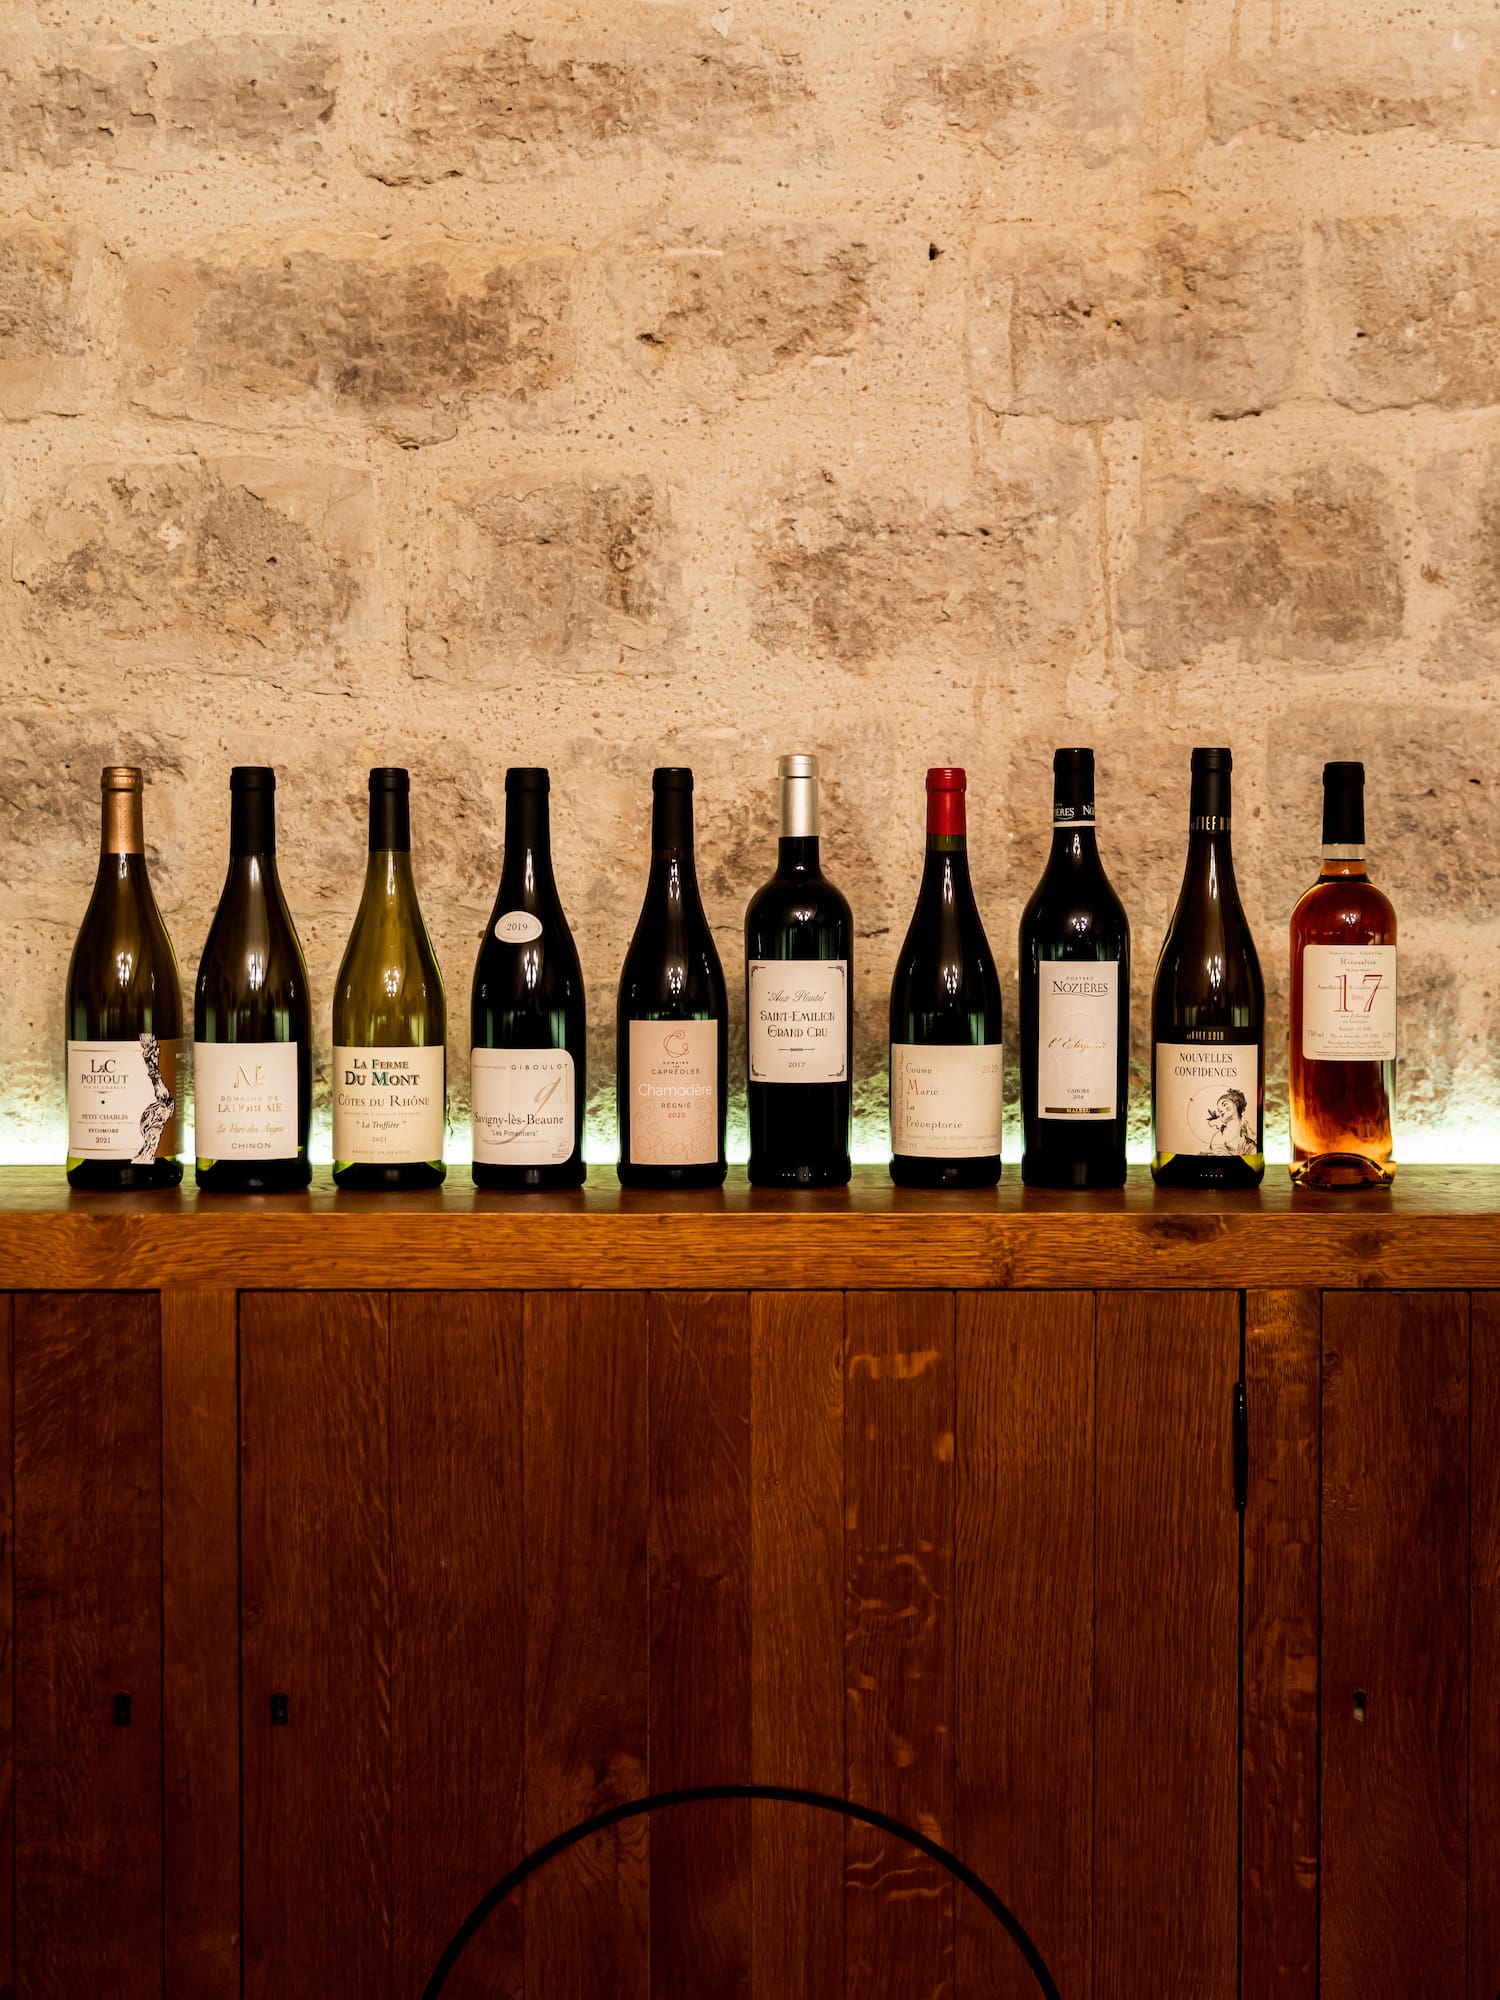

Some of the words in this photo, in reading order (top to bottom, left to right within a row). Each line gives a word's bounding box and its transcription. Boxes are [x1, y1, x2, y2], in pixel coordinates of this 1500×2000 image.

[506, 923, 527, 931] 2019
[1052, 981, 1109, 993] NOZIÈRES
[1333, 974, 1383, 1012] 17
[767, 1025, 804, 1038] GRAND
[806, 1027, 828, 1038] CRU
[353, 1059, 367, 1069] LA
[371, 1059, 409, 1069] FERME
[1179, 1053, 1233, 1063] NOUVELLES
[651, 1067, 701, 1075] CAPRÉOLES
[905, 1063, 933, 1074] Coume
[1174, 1066, 1238, 1078] CONFIDENCES
[81, 1074, 129, 1084] POITOUT
[345, 1071, 367, 1086] DU
[371, 1071, 421, 1086] MONT
[638, 1083, 713, 1097] Chamodère
[906, 1079, 939, 1096] Marie
[338, 1093, 366, 1106] CÔTES
[369, 1098, 385, 1107] DU
[390, 1095, 430, 1107] RHÔNE
[906, 1099, 915, 1111] La
[82, 1113, 98, 1121] PETIT
[99, 1113, 129, 1121] CHABLIS
[474, 1112, 564, 1128] Savigny-lès-Beaune
[906, 1115, 963, 1132] Préceptorie
